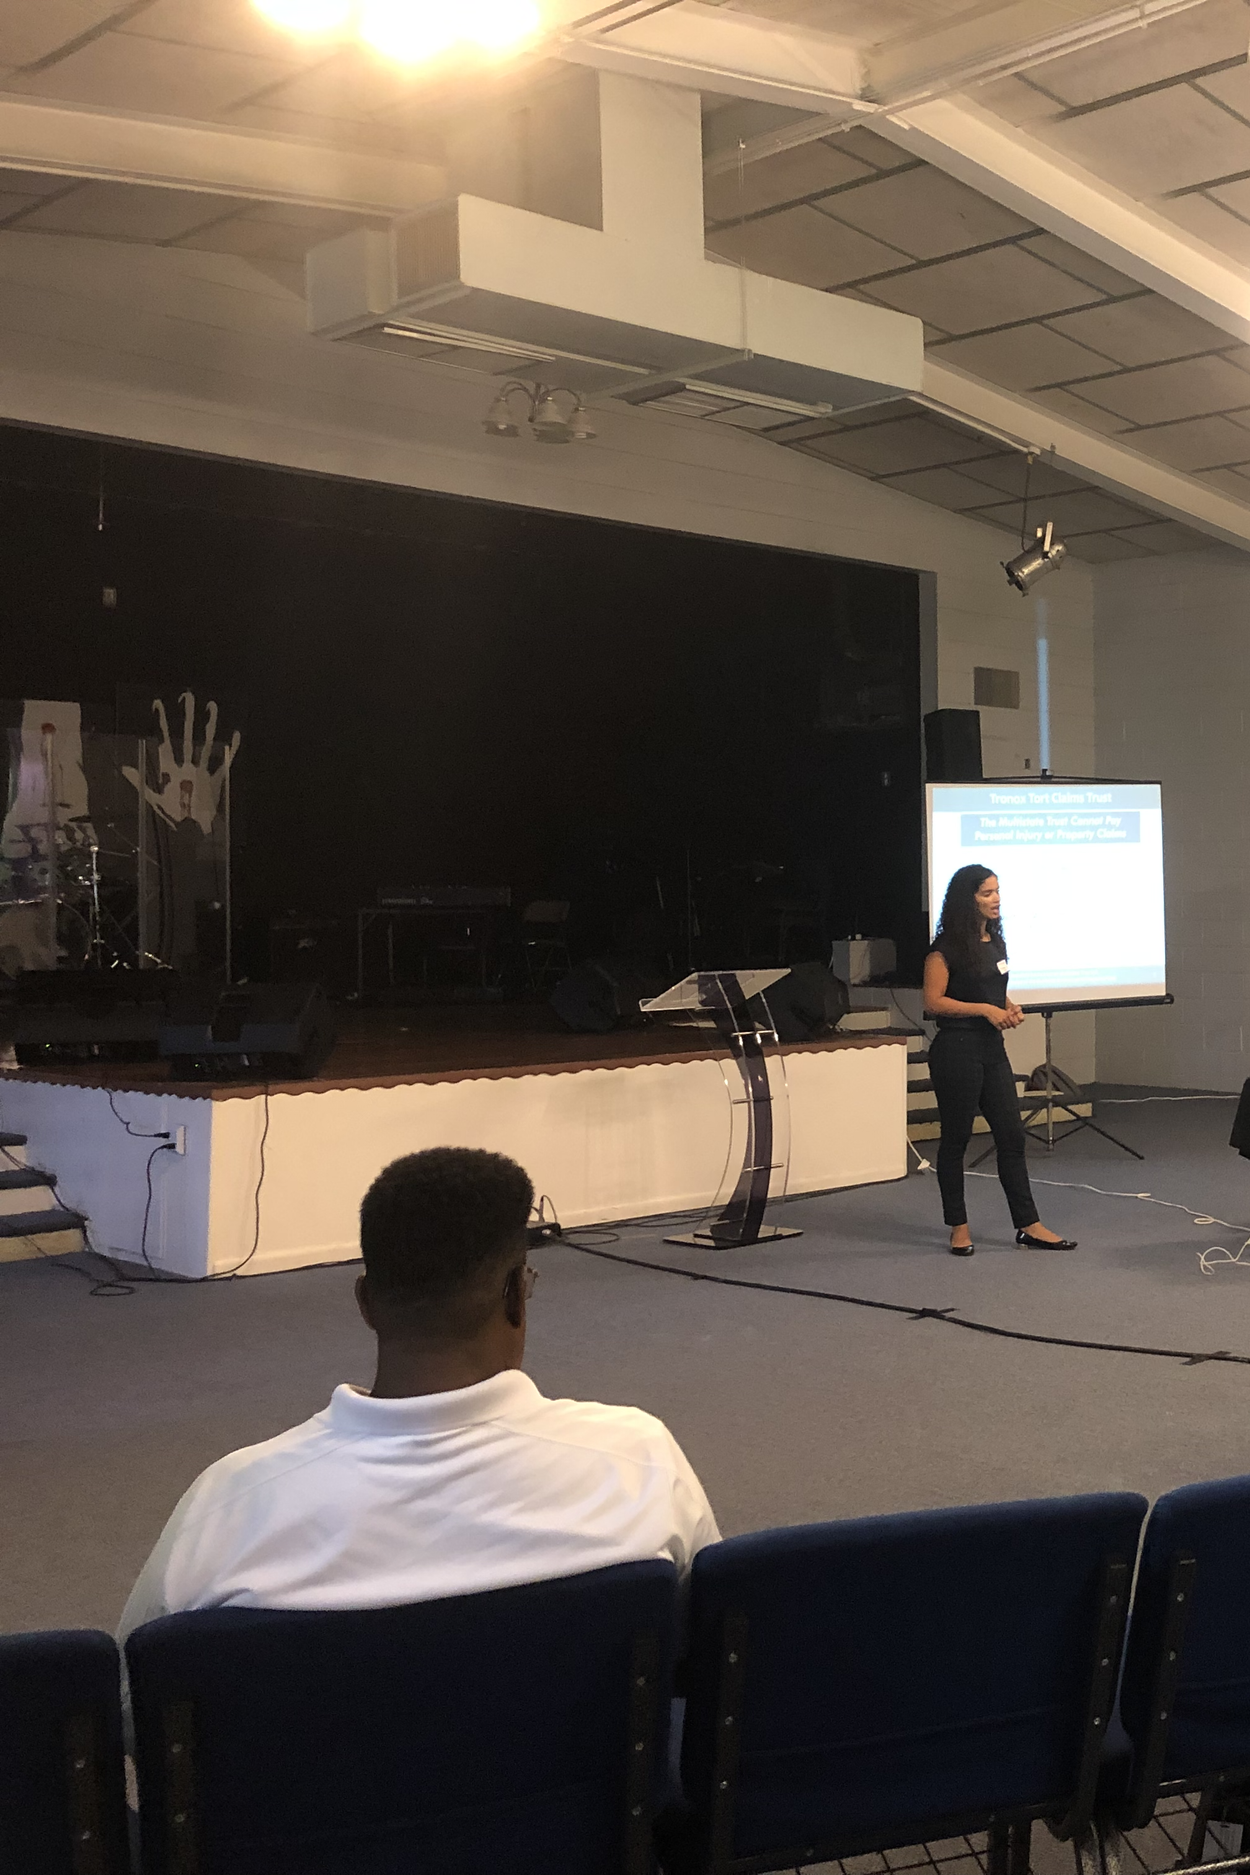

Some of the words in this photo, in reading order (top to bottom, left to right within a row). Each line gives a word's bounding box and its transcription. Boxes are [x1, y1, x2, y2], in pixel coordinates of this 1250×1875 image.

[989, 793, 1026, 804] Tronox
[1028, 793, 1050, 804] Tort
[1051, 792, 1085, 803] Claims
[1086, 792, 1112, 803] Trust
[980, 817, 996, 828] The
[998, 816, 1044, 827] Multistate
[1046, 816, 1069, 826] Trust
[1070, 815, 1104, 826] Cannot
[1105, 815, 1122, 827] Pay
[975, 830, 1014, 841] Personal
[1015, 830, 1042, 842] Injury
[1044, 831, 1055, 840] or
[1056, 829, 1095, 841] Property
[1096, 828, 1127, 839] Claims
